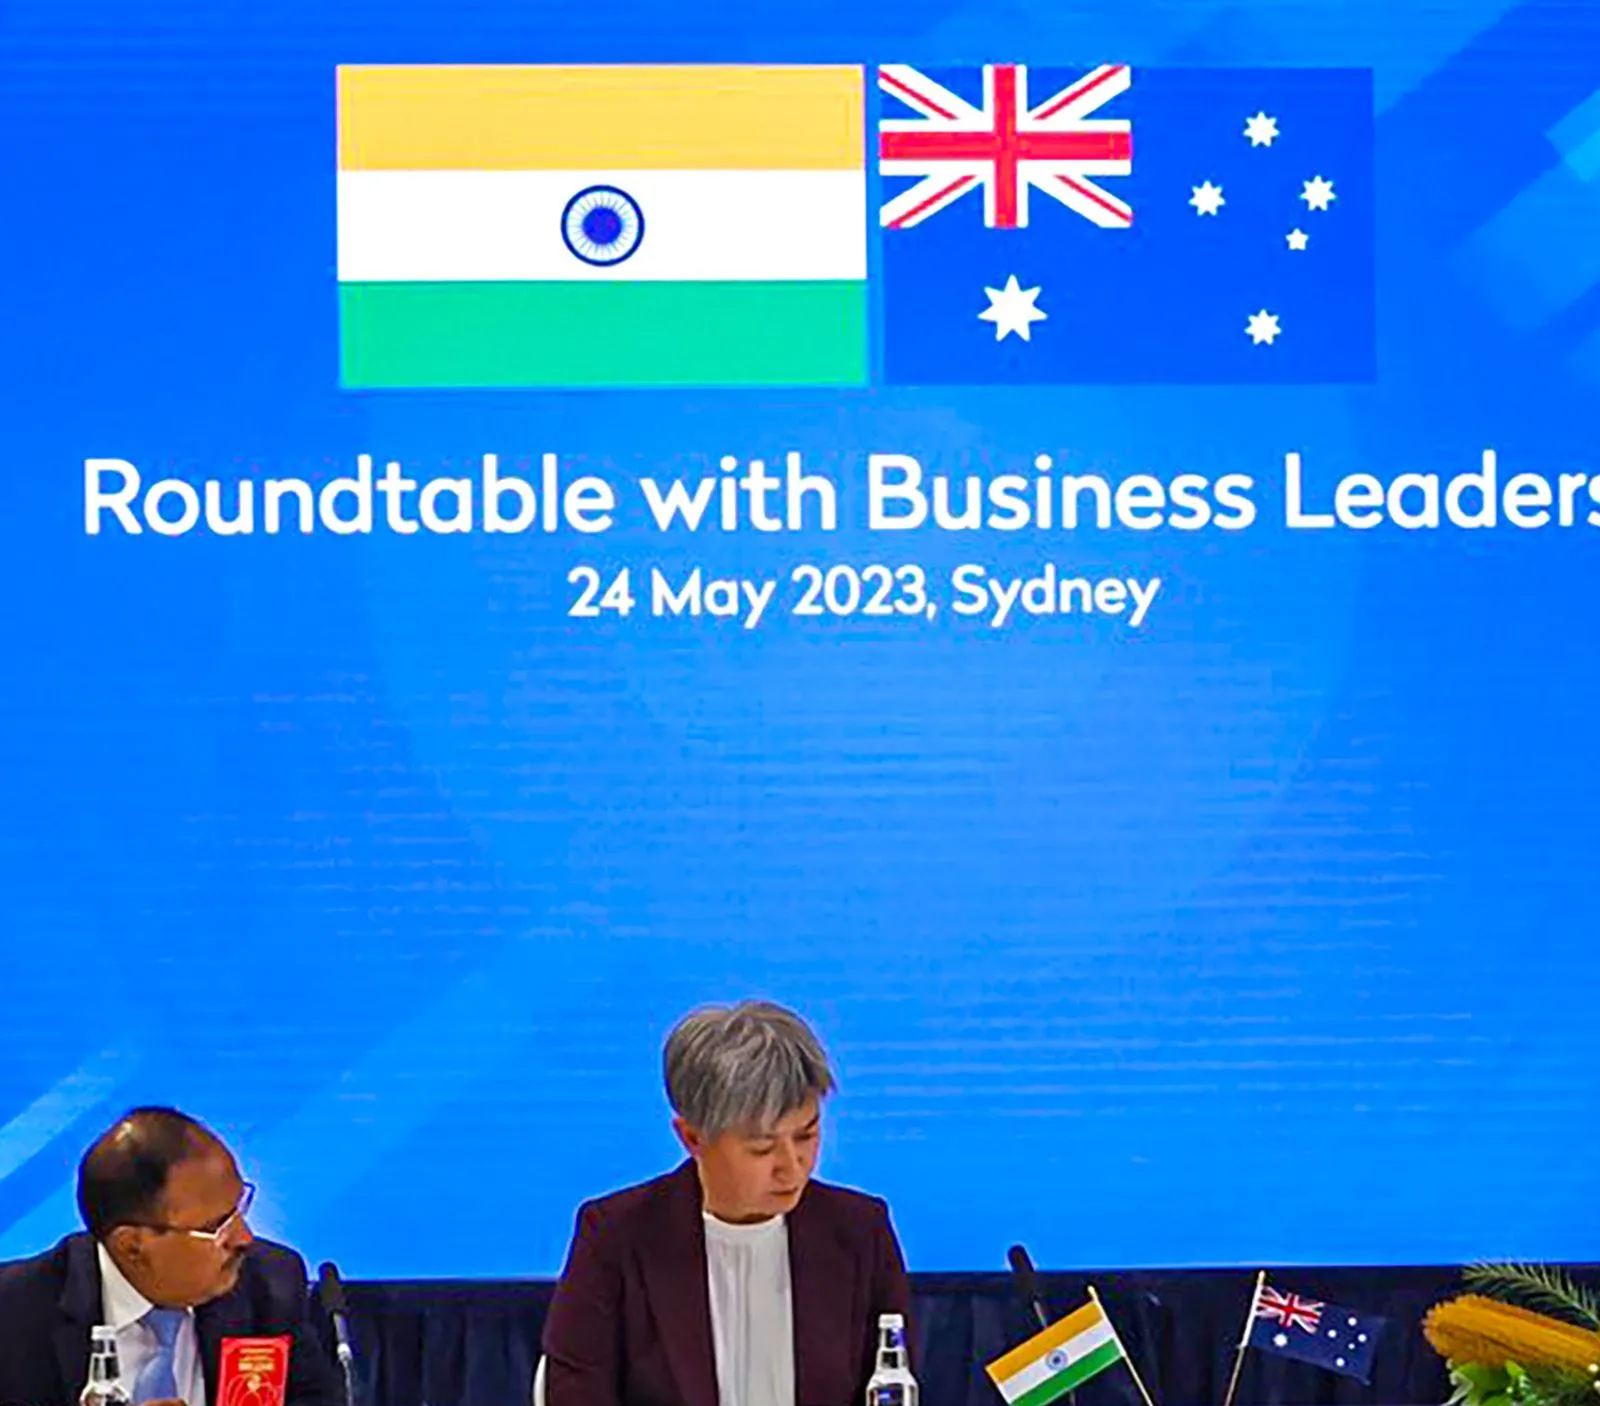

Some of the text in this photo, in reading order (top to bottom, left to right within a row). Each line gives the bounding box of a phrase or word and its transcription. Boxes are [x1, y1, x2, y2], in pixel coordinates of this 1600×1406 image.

[85, 453, 615, 536] Roundtable
[639, 451, 836, 532] with
[868, 454, 1256, 531] Business
[568, 563, 1161, 629] 24 May 2023, Sydney
